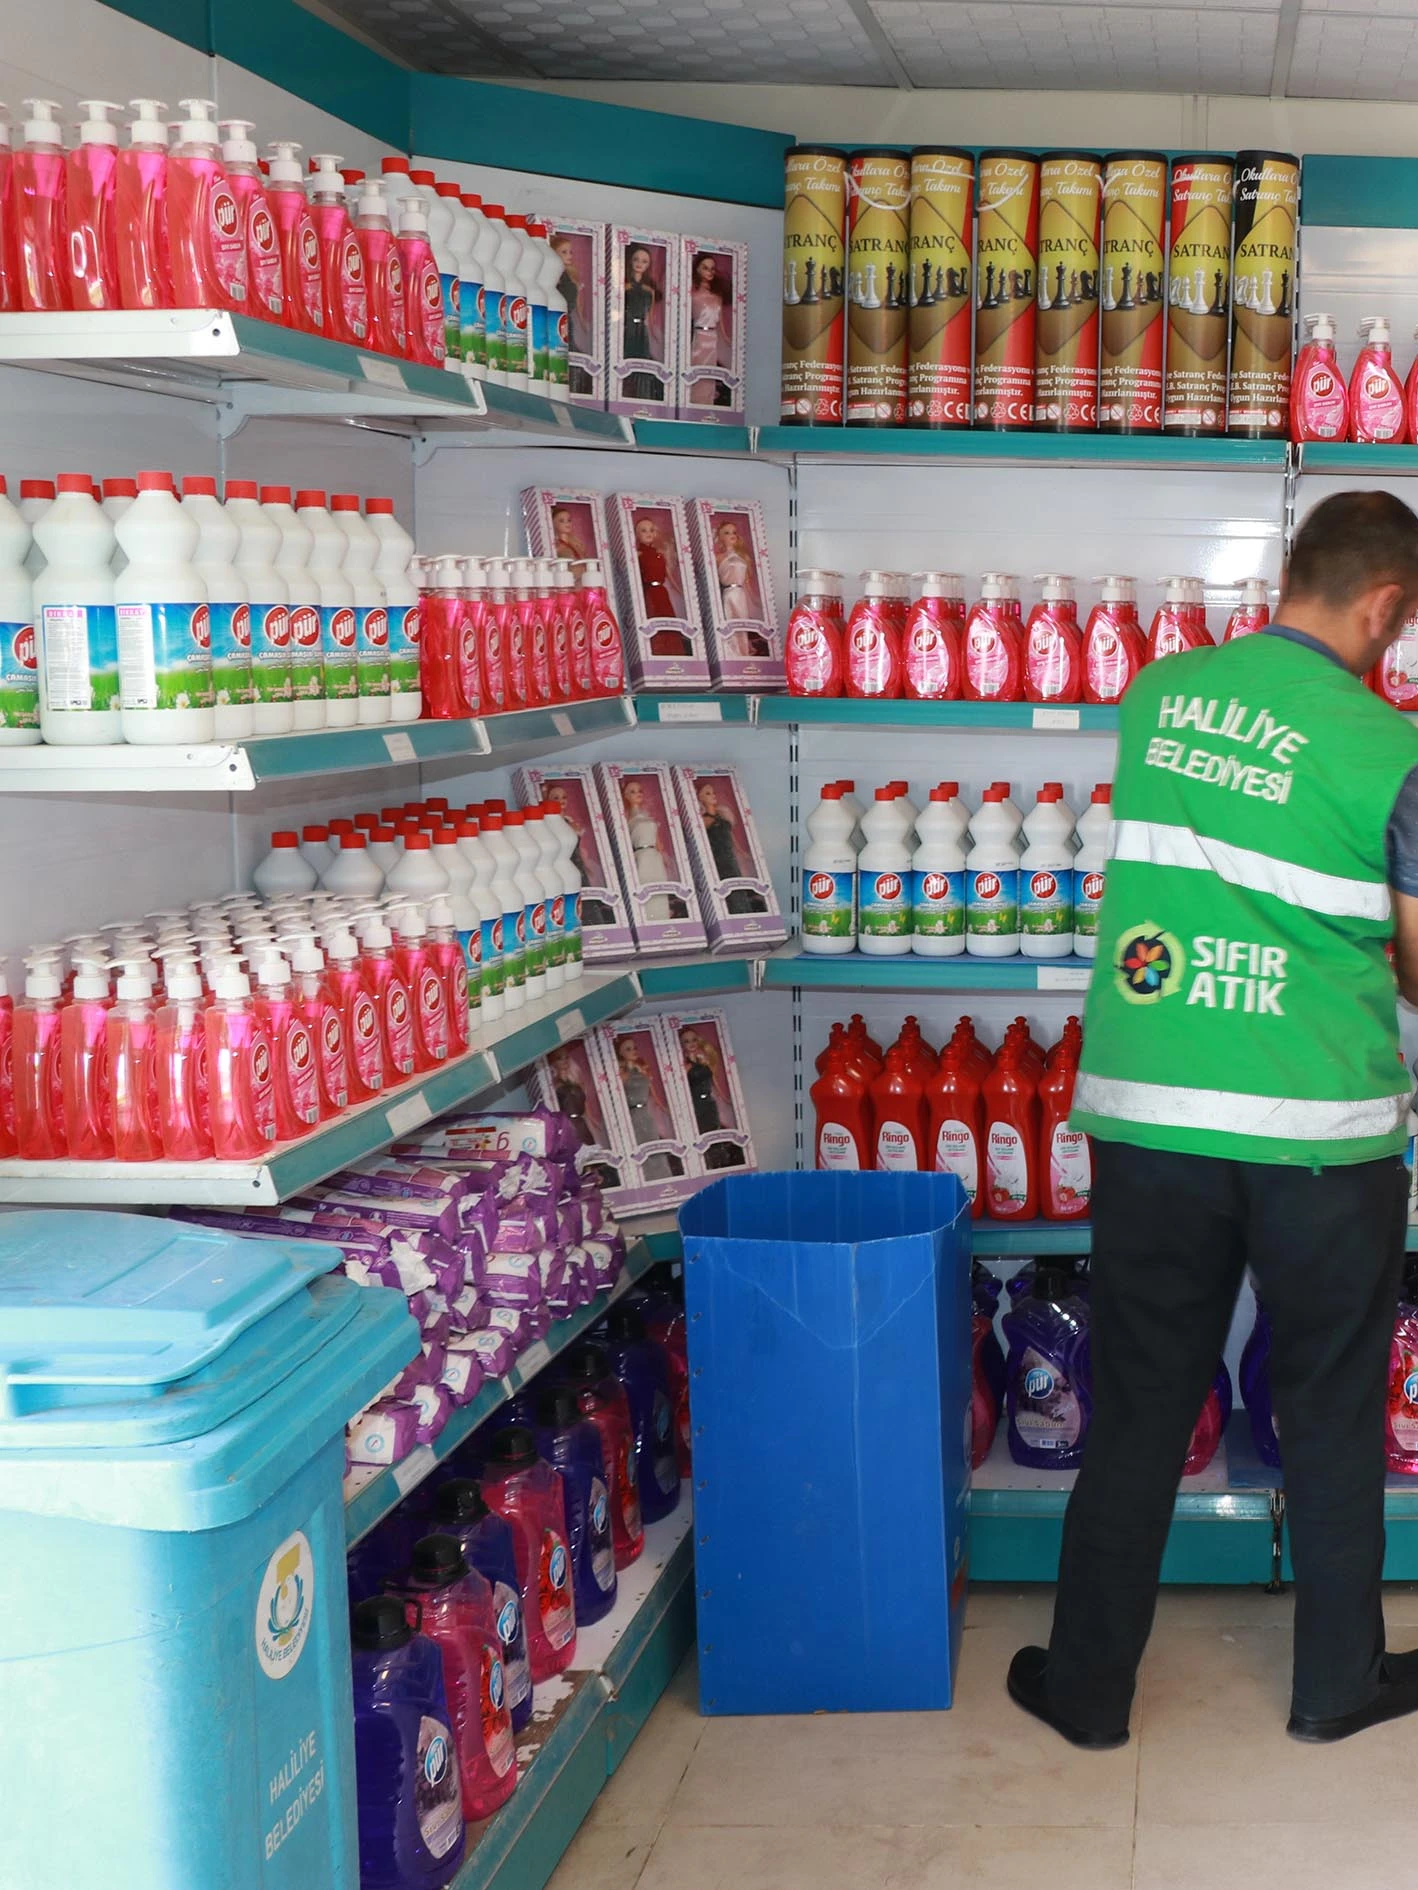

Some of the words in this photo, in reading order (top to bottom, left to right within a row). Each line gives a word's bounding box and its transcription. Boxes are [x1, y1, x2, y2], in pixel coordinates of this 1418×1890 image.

[1064, 160, 1095, 177] Özel
[1131, 161, 1161, 178] Özel
[1240, 167, 1289, 181] Okullara
[1240, 187, 1281, 203] Satranç
[1313, 376, 1332, 394] pür
[293, 613, 318, 640] pür
[1158, 695, 1310, 765] HALİLİYE
[1144, 737, 1294, 804] BELEDİYESİ
[812, 877, 830, 896] pür
[878, 877, 897, 896] pür
[977, 876, 997, 896] pür
[1033, 876, 1053, 896] pür
[1190, 935, 1289, 978] SIFIR
[1185, 971, 1287, 1016] ATIK
[823, 1132, 849, 1147] Ringo
[882, 1131, 909, 1146] Ringo
[942, 1131, 969, 1146] Ringo
[991, 1133, 1017, 1147] Ringo
[1056, 1132, 1083, 1147] Ringo
[1028, 1374, 1048, 1398] pür
[269, 1730, 316, 1803] HALİLİYE
[264, 1759, 325, 1861] BELEDİYESİ
